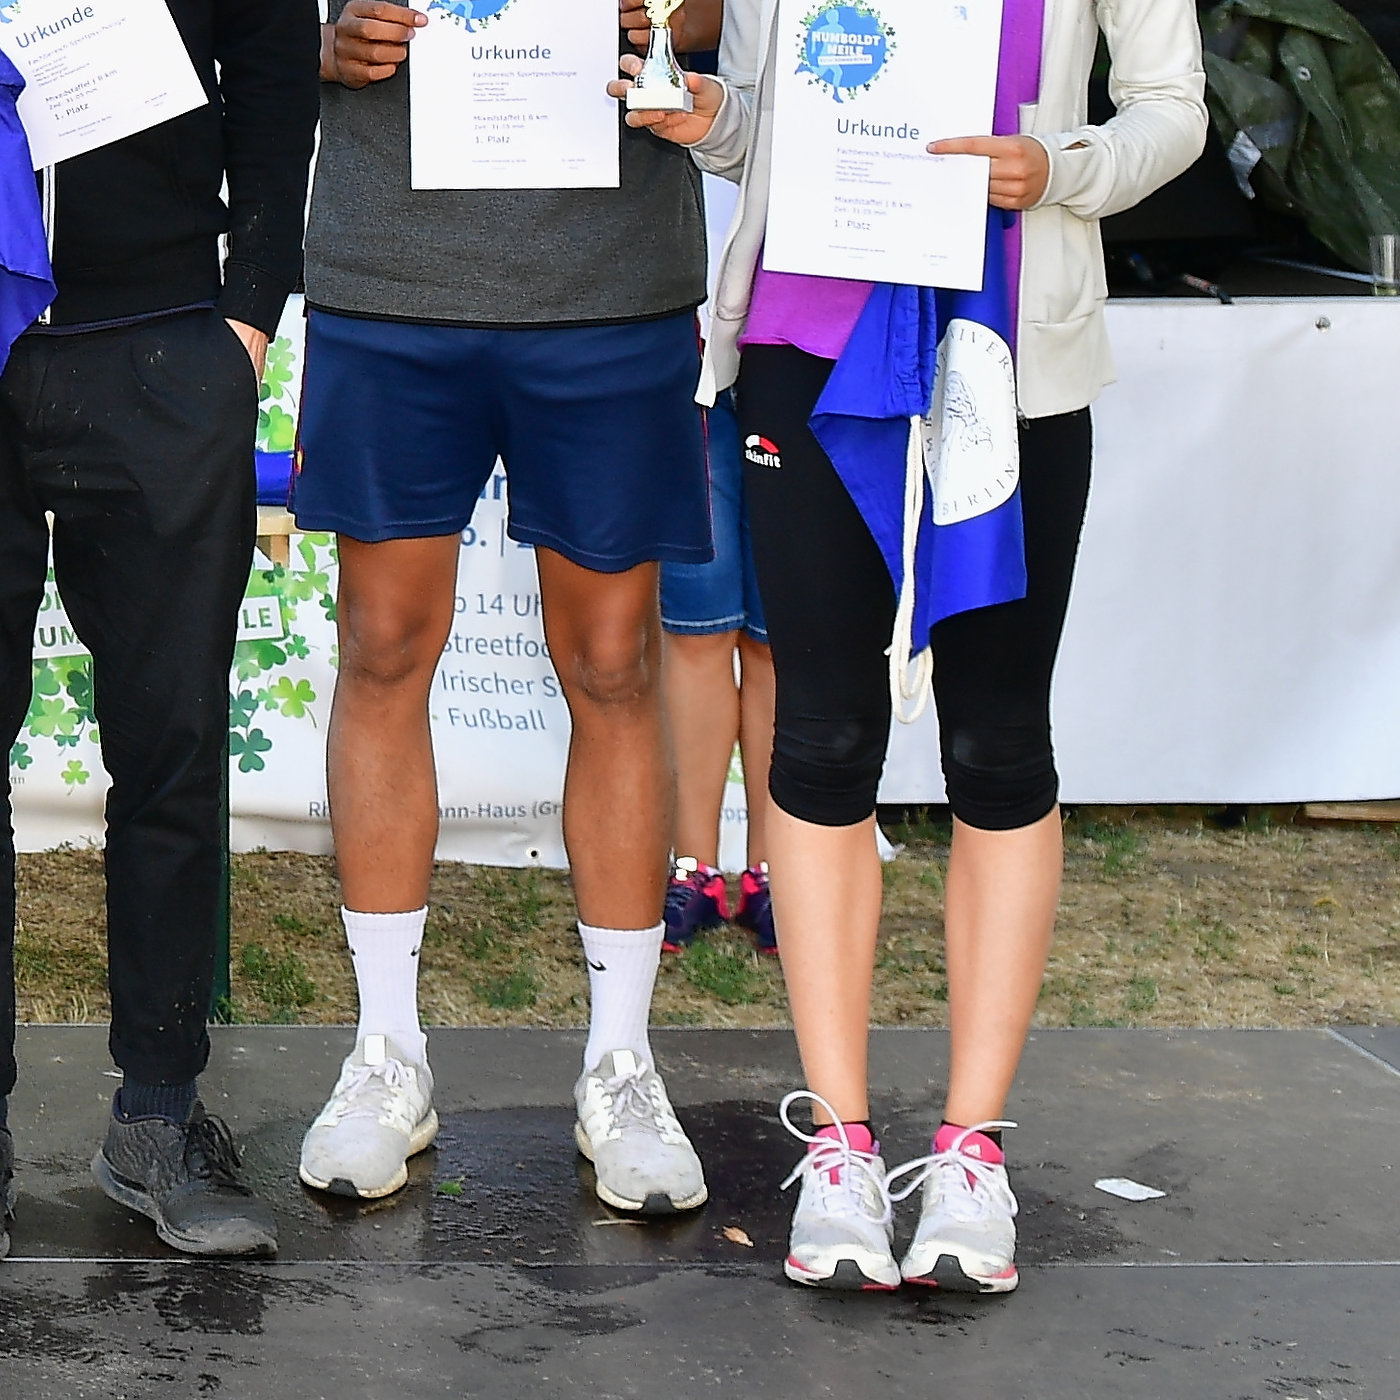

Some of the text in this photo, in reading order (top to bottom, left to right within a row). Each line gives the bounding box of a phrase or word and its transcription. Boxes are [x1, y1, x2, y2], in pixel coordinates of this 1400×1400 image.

[15, 6, 94, 48] Urkunde
[811, 31, 881, 47] HUMBOLDT
[471, 45, 551, 60] Urkunde
[66, 103, 89, 116] Platz
[487, 135, 510, 144] Platz
[837, 118, 920, 140] Urkunde
[847, 220, 870, 231] Platz
[476, 593, 504, 615] 14
[238, 607, 273, 629] LE
[36, 626, 79, 647] UM
[441, 670, 535, 696] Irischer
[448, 707, 547, 731] Fußball
